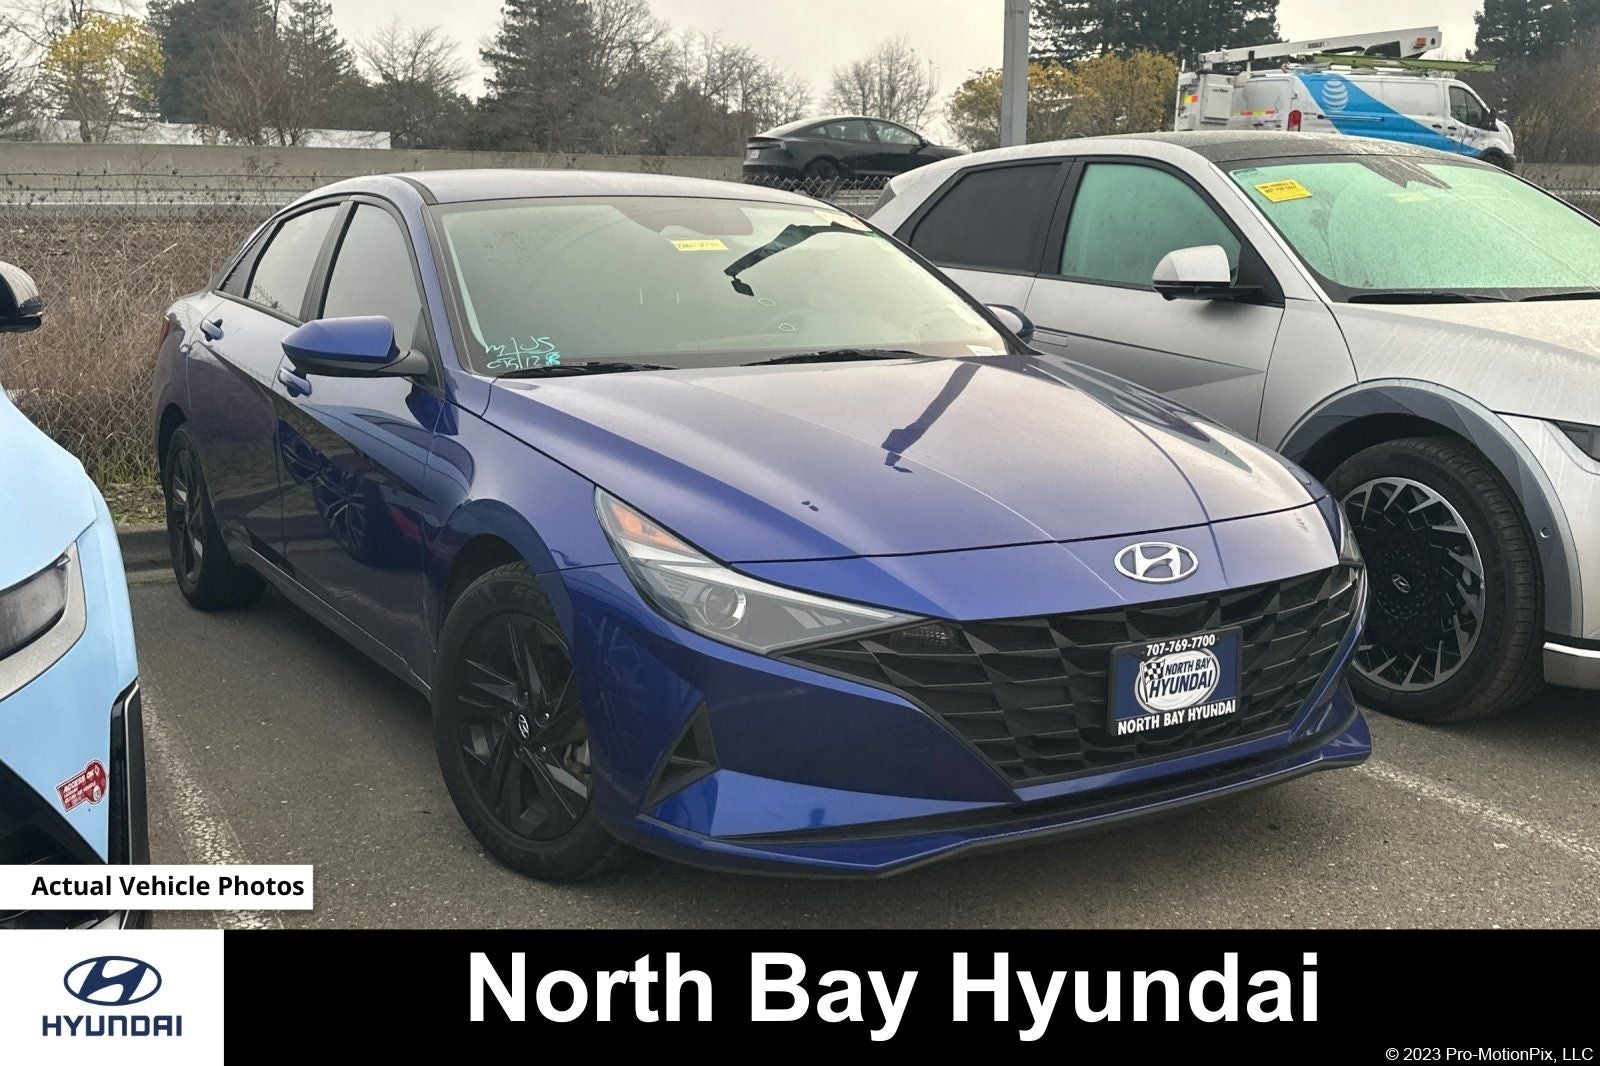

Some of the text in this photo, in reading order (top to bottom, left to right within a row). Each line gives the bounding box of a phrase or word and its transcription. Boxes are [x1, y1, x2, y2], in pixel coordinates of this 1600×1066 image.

[1146, 634, 1216, 656] 707-769-7700
[1165, 657, 1212, 676] NORTH BAY
[1149, 670, 1214, 698] HYUNDAI
[1118, 700, 1236, 736] NORTH BAY HYUNDAI
[63, 774, 86, 793] ACCESS
